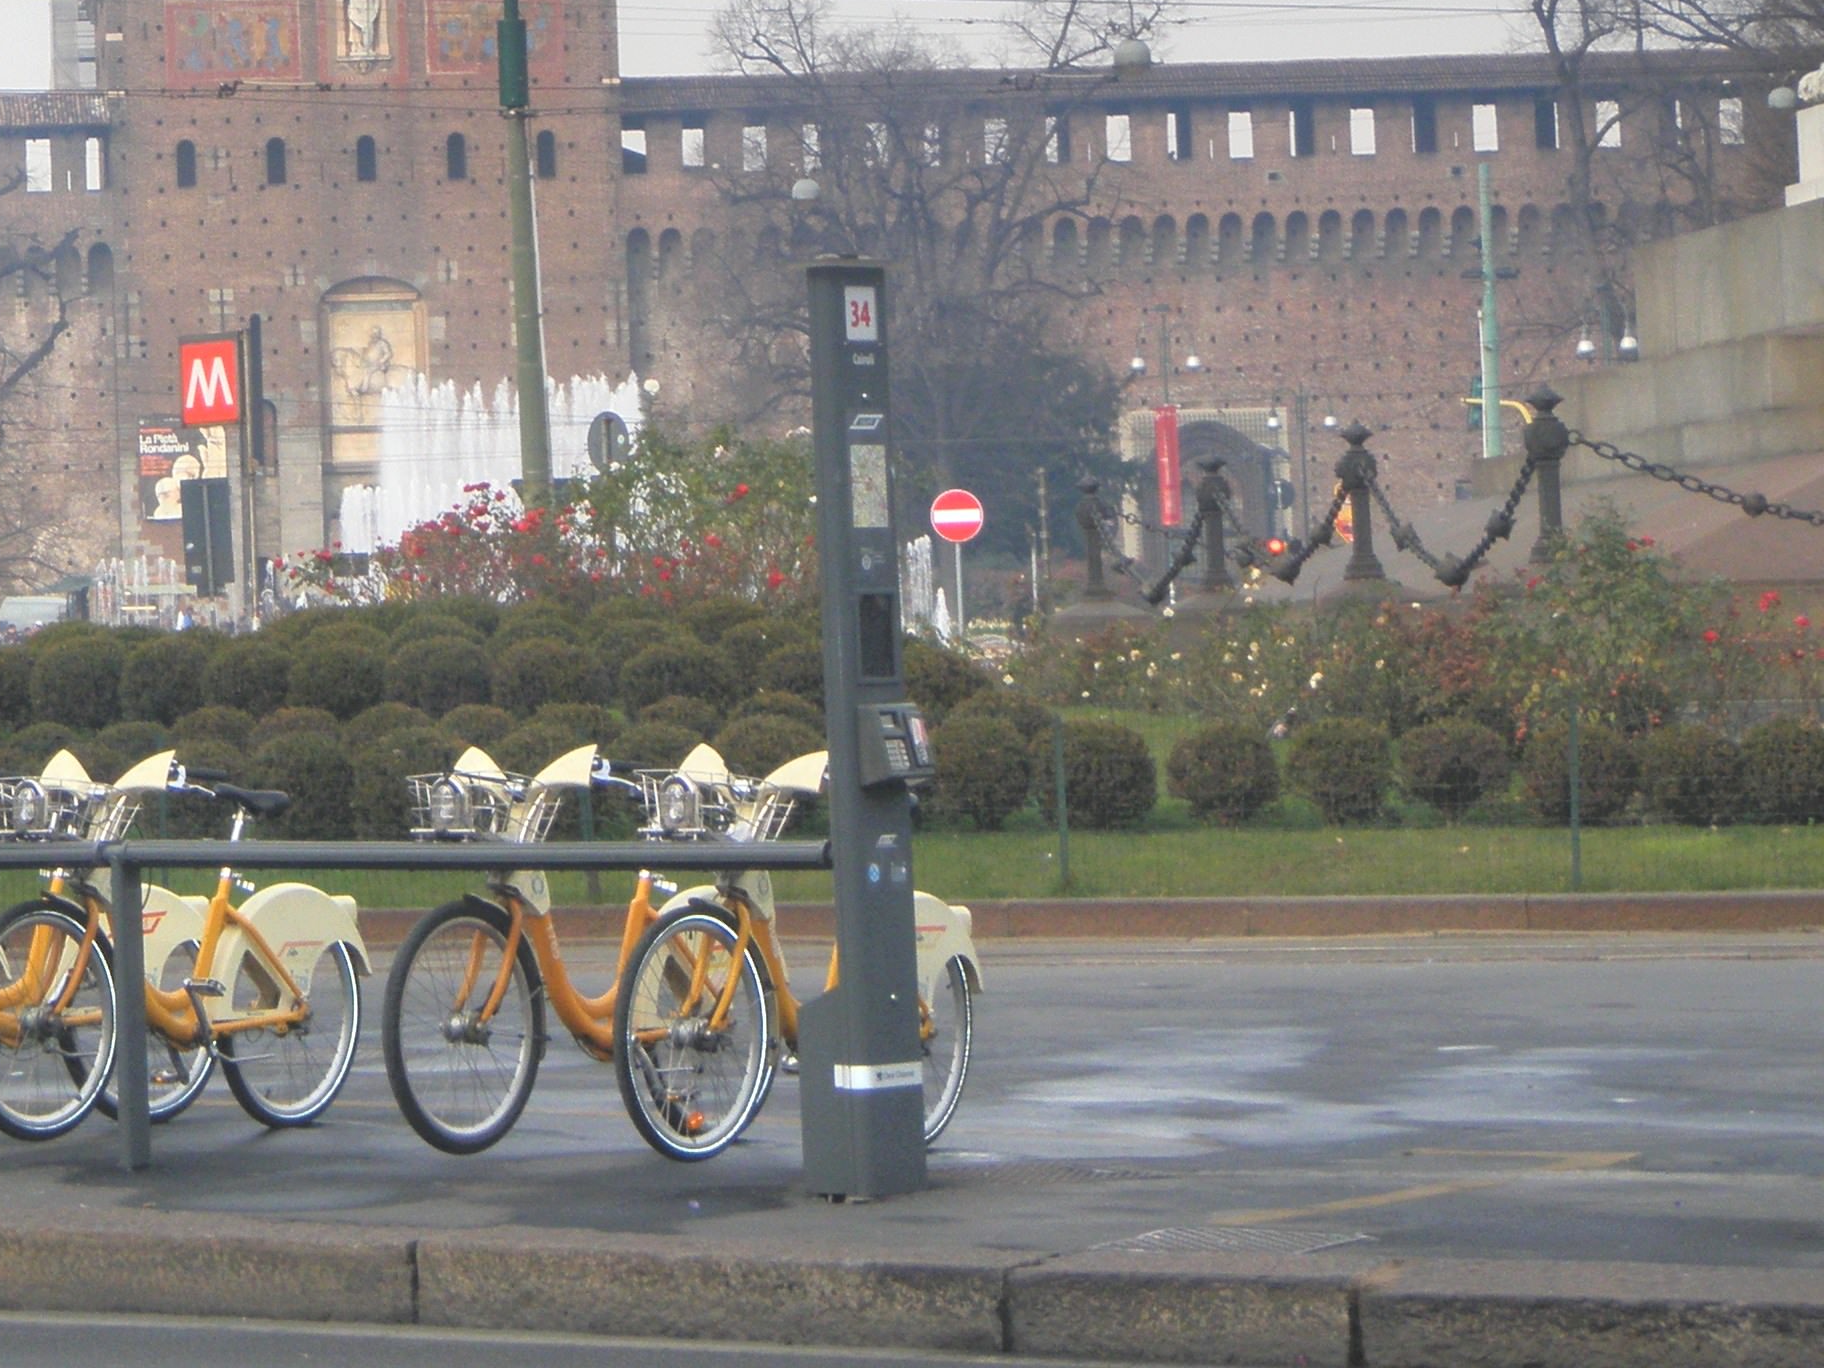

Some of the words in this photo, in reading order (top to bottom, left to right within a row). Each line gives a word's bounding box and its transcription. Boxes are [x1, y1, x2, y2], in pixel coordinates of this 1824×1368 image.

[850, 300, 871, 328] 34
[186, 356, 234, 409] M
[139, 434, 152, 444] La
[153, 433, 178, 443] Pietà
[139, 442, 189, 454] Rondanini
